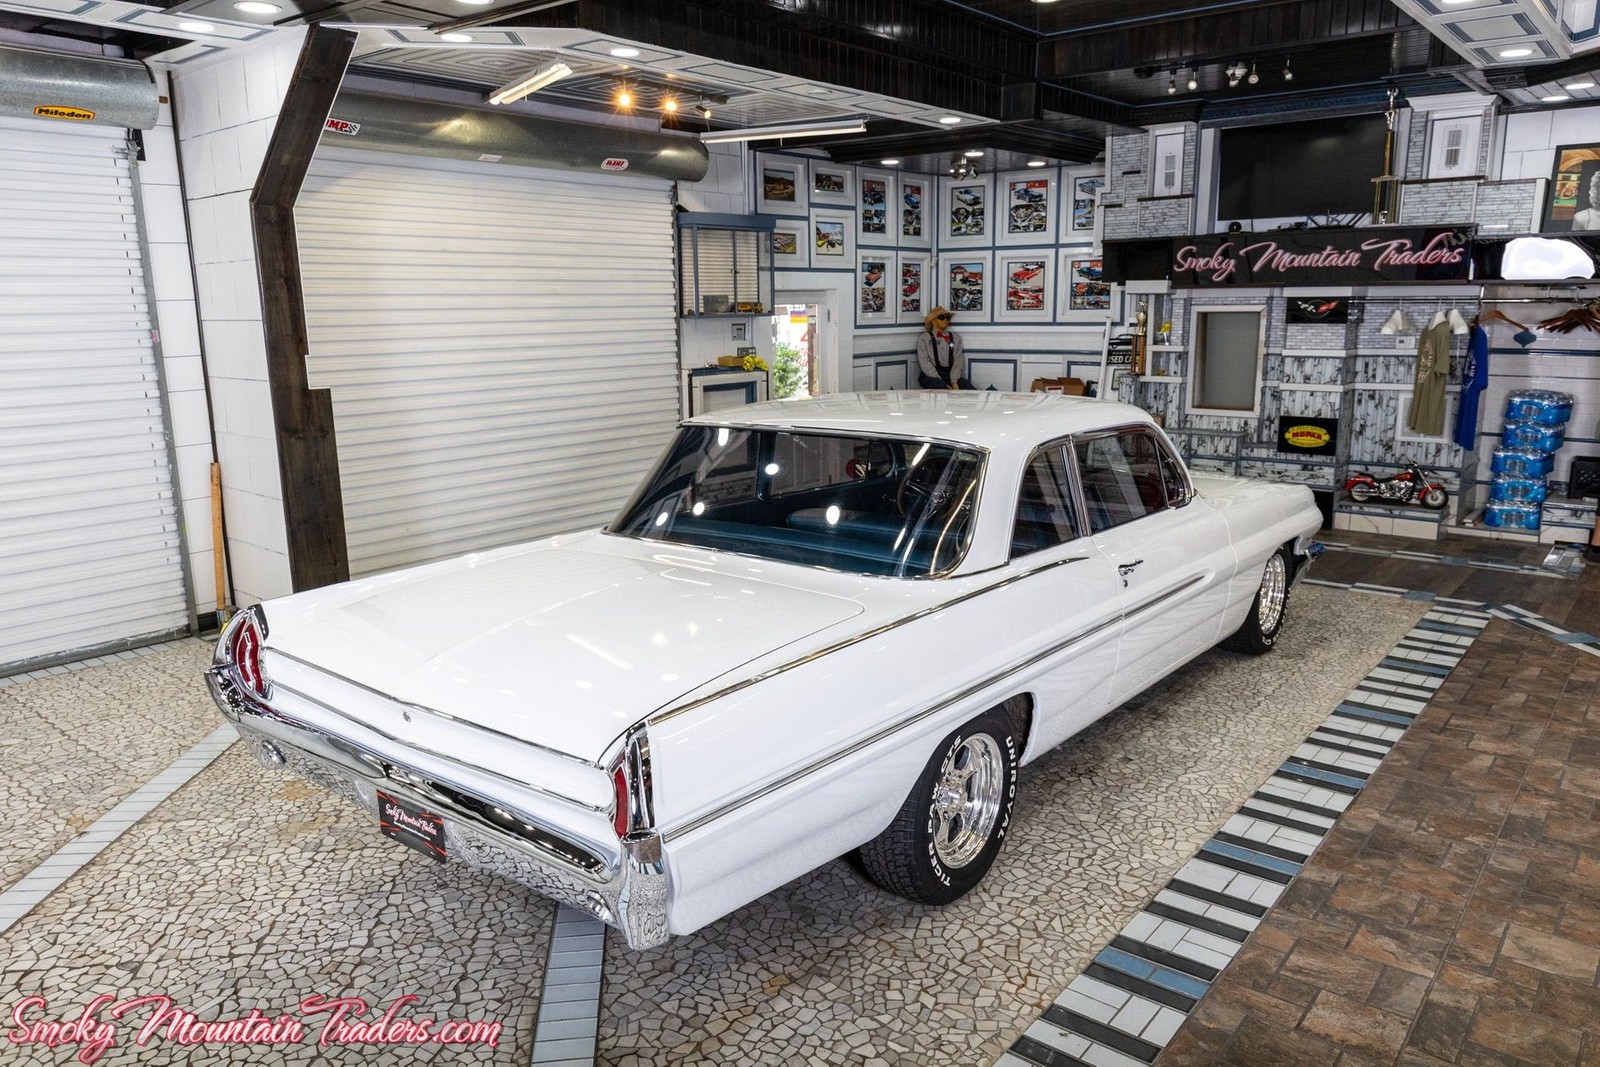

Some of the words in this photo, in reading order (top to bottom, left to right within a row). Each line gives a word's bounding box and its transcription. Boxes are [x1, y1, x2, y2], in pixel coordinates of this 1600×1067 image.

[37, 108, 91, 119] Milodon
[1173, 242, 1236, 282] Smoky
[1239, 241, 1361, 272] Mountain
[1361, 232, 1464, 271] Traders
[997, 735, 1018, 839] UNIROYAL
[928, 841, 951, 887] TIGER
